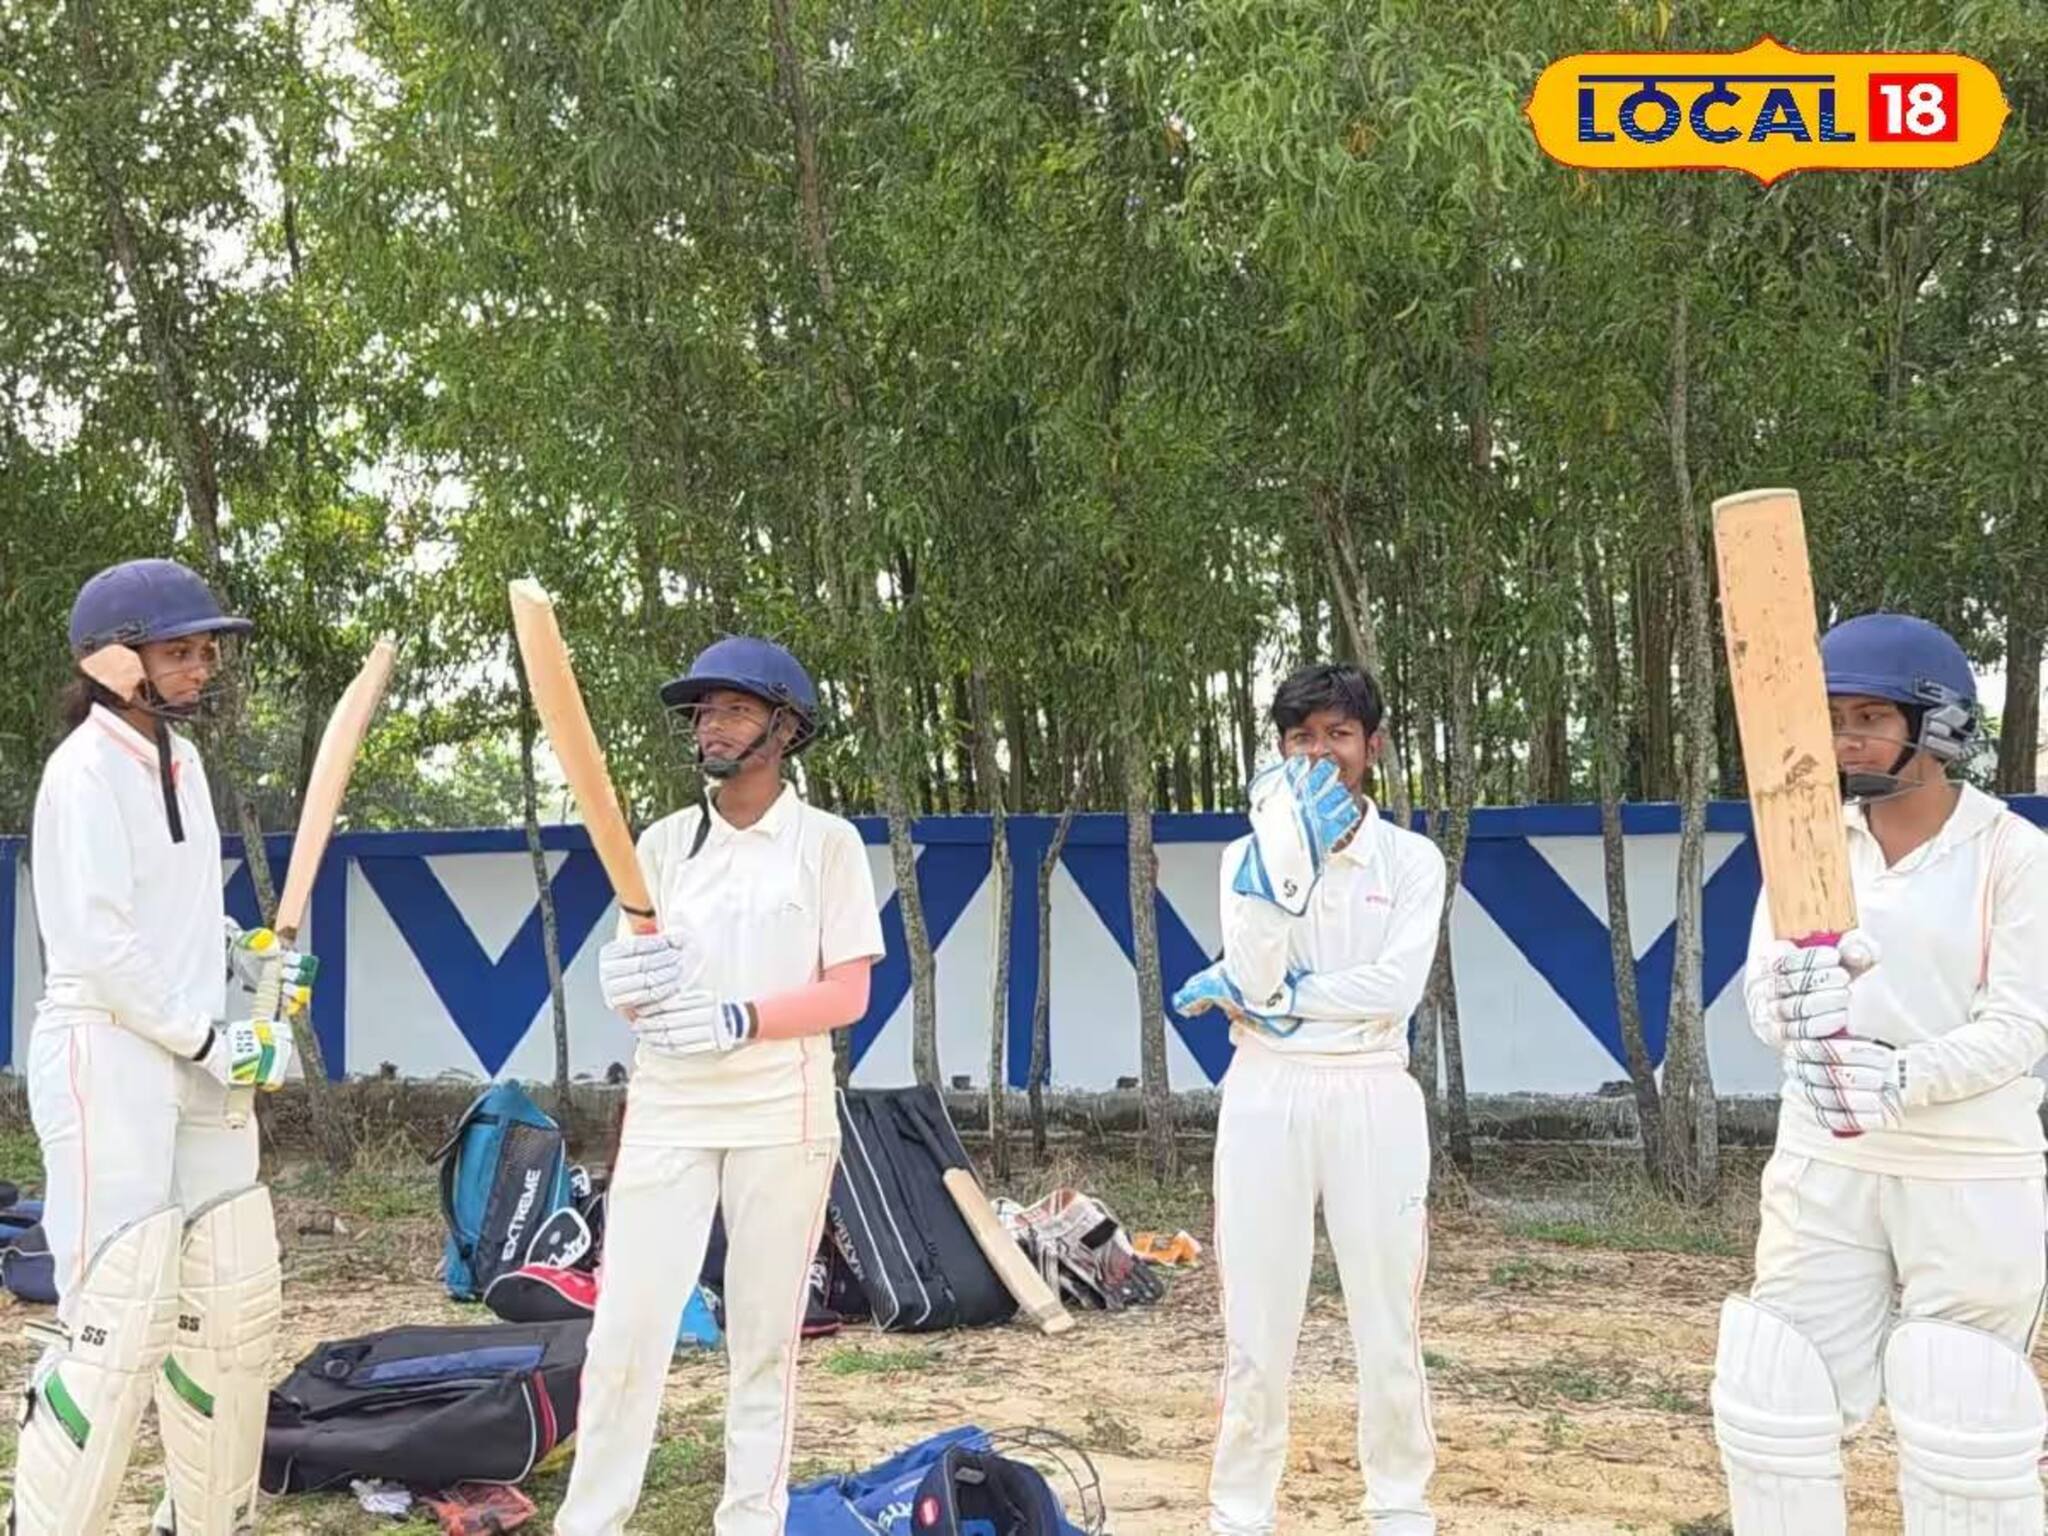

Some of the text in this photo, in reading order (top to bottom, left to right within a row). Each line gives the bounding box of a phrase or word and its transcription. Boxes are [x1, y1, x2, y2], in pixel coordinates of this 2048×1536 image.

[501, 1168, 542, 1262] EXTREME
[177, 1314, 201, 1333] SS
[80, 1324, 108, 1346] SS
